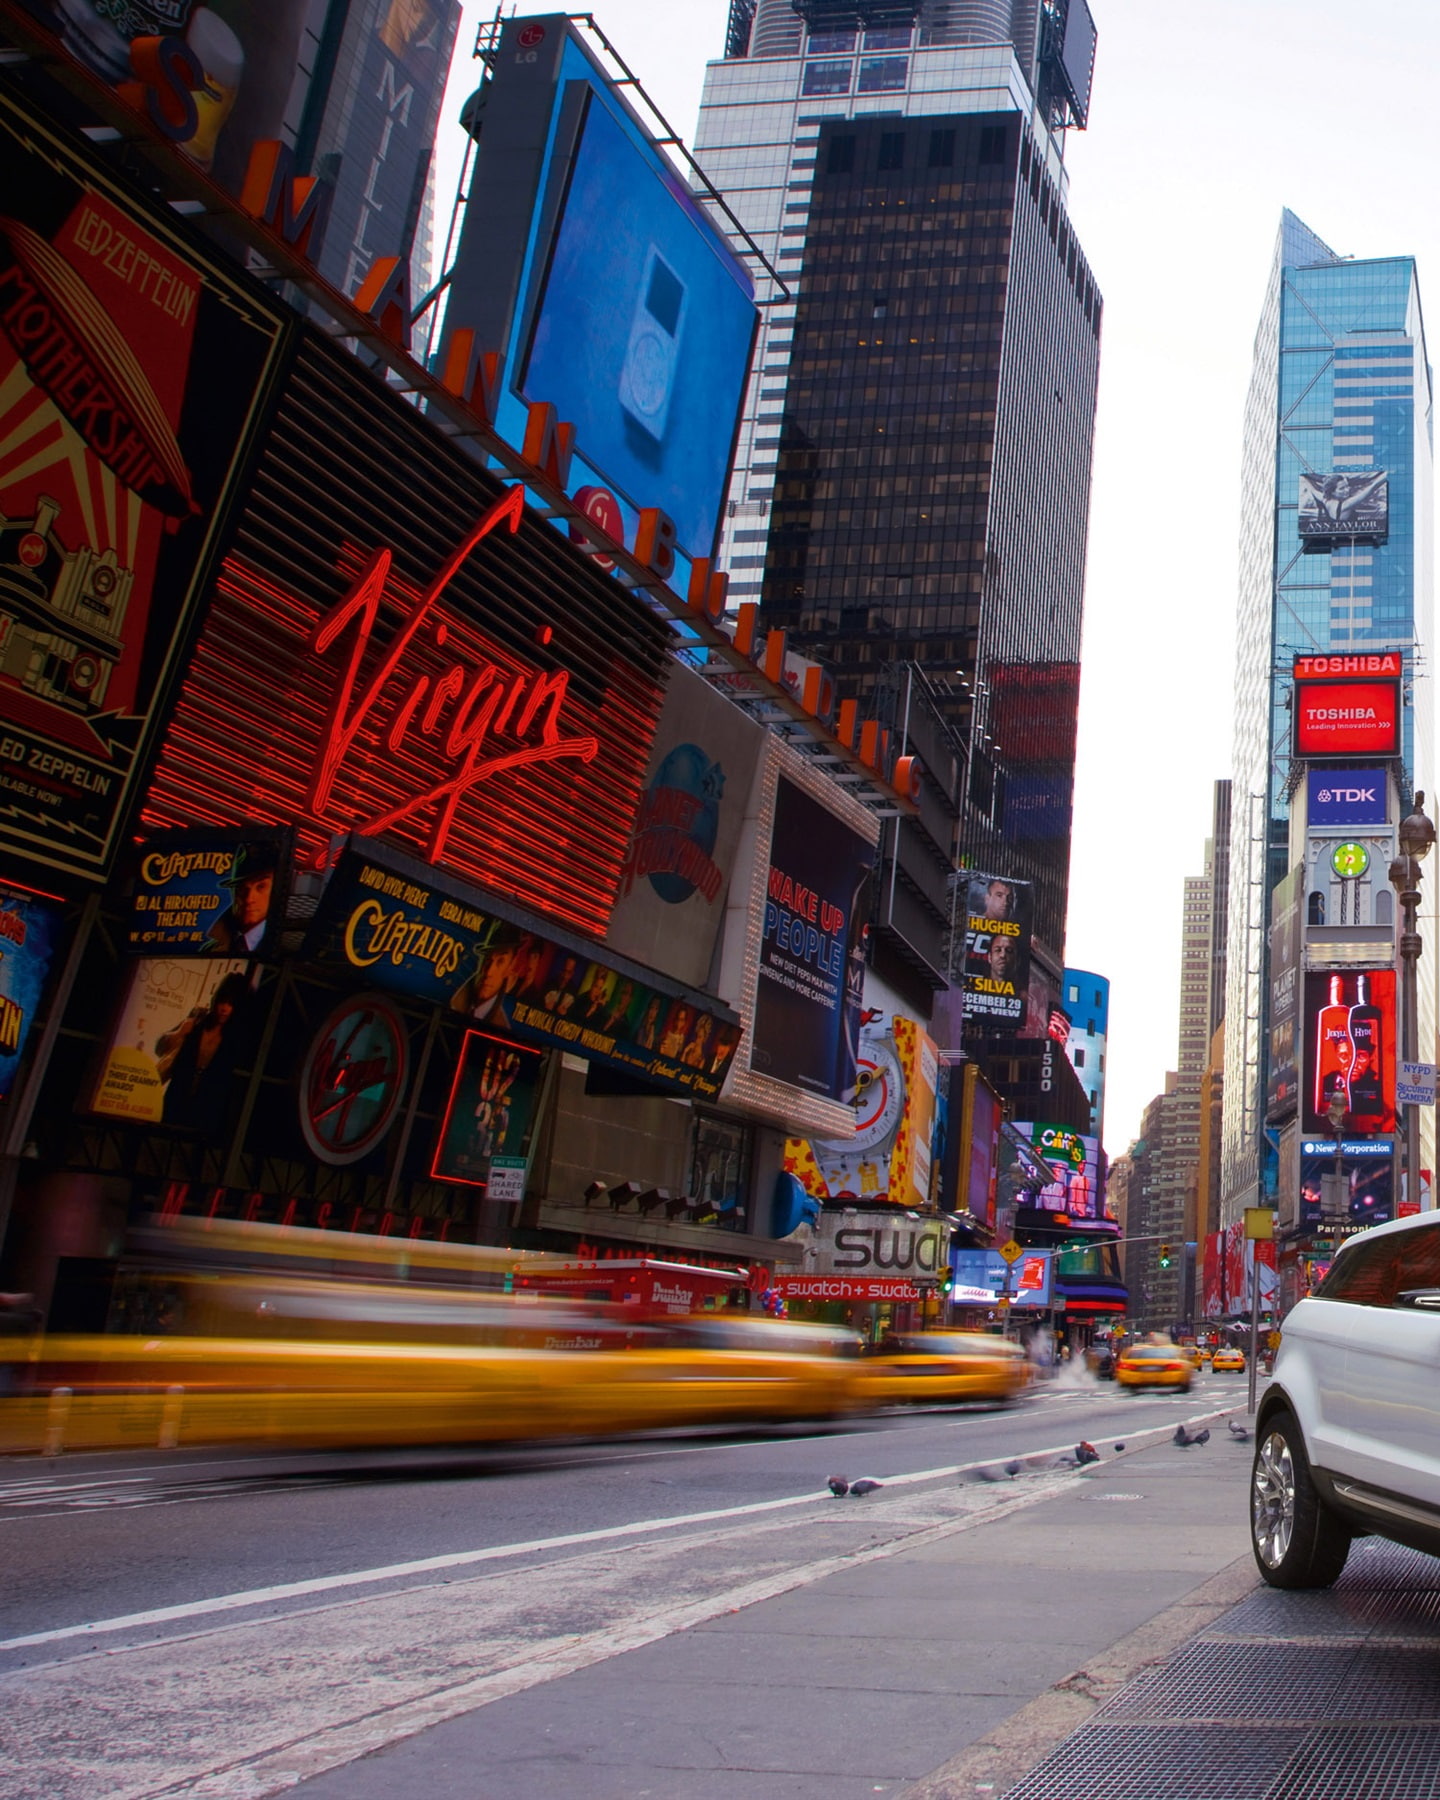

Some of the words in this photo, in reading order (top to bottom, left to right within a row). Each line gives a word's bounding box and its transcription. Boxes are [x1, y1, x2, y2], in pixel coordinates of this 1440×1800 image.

[515, 51, 537, 63] LG
[1307, 522, 1330, 530] ANN
[1334, 520, 1378, 529] TAYLOR
[1300, 655, 1396, 673] TOSHIBA
[314, 484, 600, 864] Virgin
[1306, 708, 1376, 720] TOSHIBA
[1306, 722, 1335, 732] Leading
[1337, 721, 1376, 730] Innovation
[0, 737, 27, 762] ED
[31, 748, 112, 798] ZEPPELIN
[1331, 788, 1376, 802] TDK
[141, 851, 234, 886] CURTAINS
[149, 896, 163, 911] AL
[164, 895, 220, 911] HIRSCHFELD
[359, 865, 385, 890] DAVID
[382, 876, 406, 899] HYDE
[402, 884, 431, 910] PIERCE
[460, 909, 486, 933] MONK
[768, 865, 819, 926] WAKE
[820, 902, 845, 938] UP
[157, 911, 198, 927] THEATRE
[971, 918, 1021, 937] HUGHES
[345, 898, 465, 978] CURTAINS
[763, 901, 844, 979] PEOPLE
[769, 952, 784, 968] NEW
[797, 964, 811, 983] PEPSI
[811, 972, 824, 988] MAX
[824, 980, 839, 996] WITH
[795, 981, 811, 1000] MORE
[974, 978, 1016, 996] SILVA
[1008, 997, 1022, 1010] 29
[512, 1001, 530, 1023] THE
[525, 1008, 556, 1034] MUSICAL
[553, 1018, 584, 1042] COMEDY
[1404, 1063, 1431, 1075] NYPD
[107, 1069, 128, 1083] THREE
[129, 1073, 161, 1088] GRAMMY
[1397, 1081, 1434, 1095] SECURITY
[1398, 1091, 1432, 1103] CAMERA
[1341, 1143, 1390, 1155] Corporation
[489, 1180, 523, 1190] SHARED
[492, 1189, 516, 1198] LANE
[652, 1281, 694, 1306] Dunbar
[787, 1280, 853, 1298] swatch
[544, 1336, 603, 1350] Dunbar
